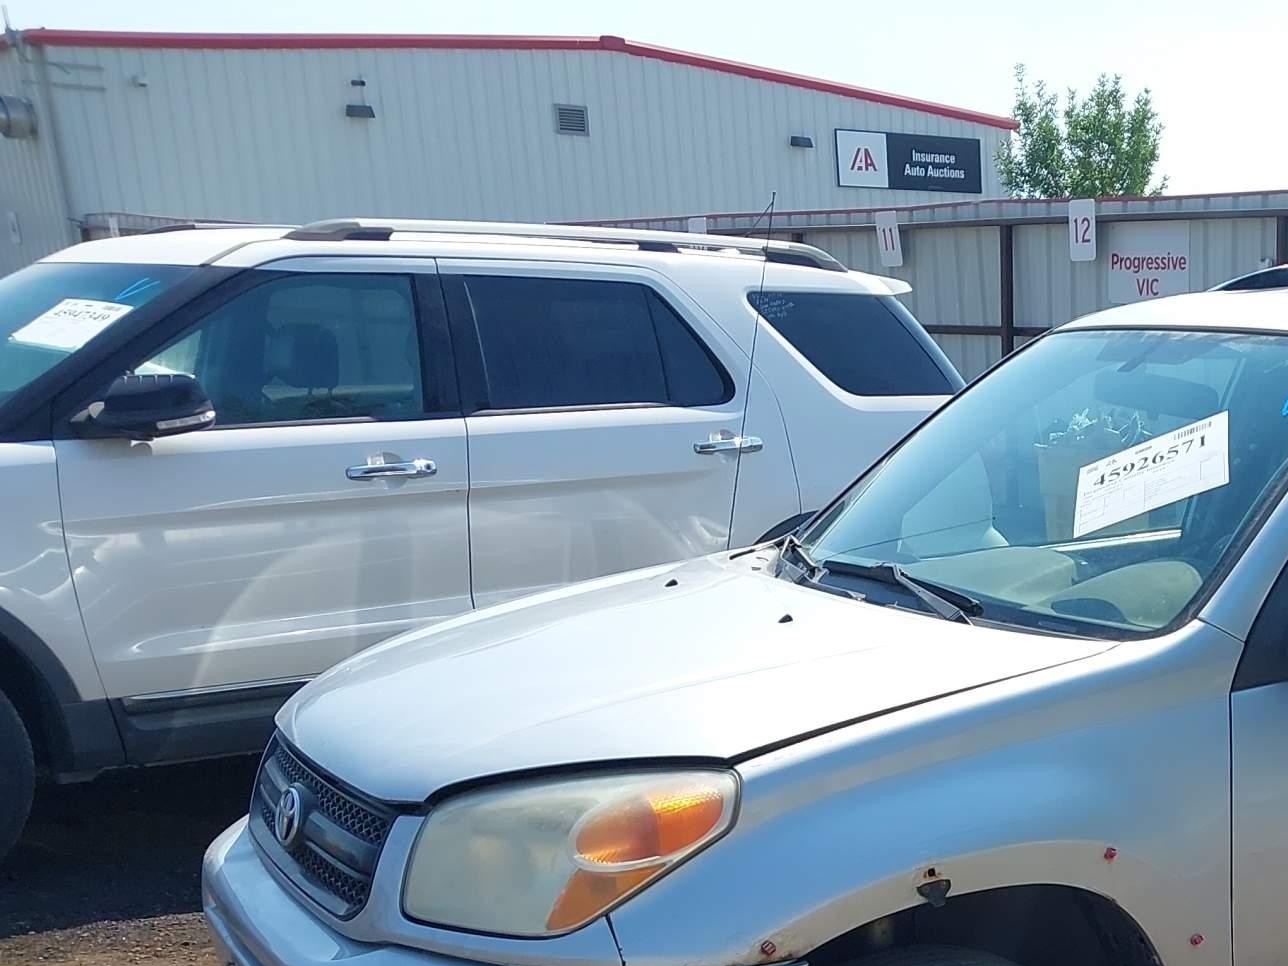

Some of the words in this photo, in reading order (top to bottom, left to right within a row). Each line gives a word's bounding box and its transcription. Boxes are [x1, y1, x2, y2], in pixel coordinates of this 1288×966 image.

[912, 149, 955, 164] Insurance
[904, 163, 925, 177] Auto
[927, 165, 965, 179] Auctions
[882, 227, 895, 251] 11
[1073, 217, 1091, 243] 12
[1111, 252, 1187, 273] Progressive
[1136, 278, 1159, 296] VIC
[1093, 434, 1205, 486] 45926571
